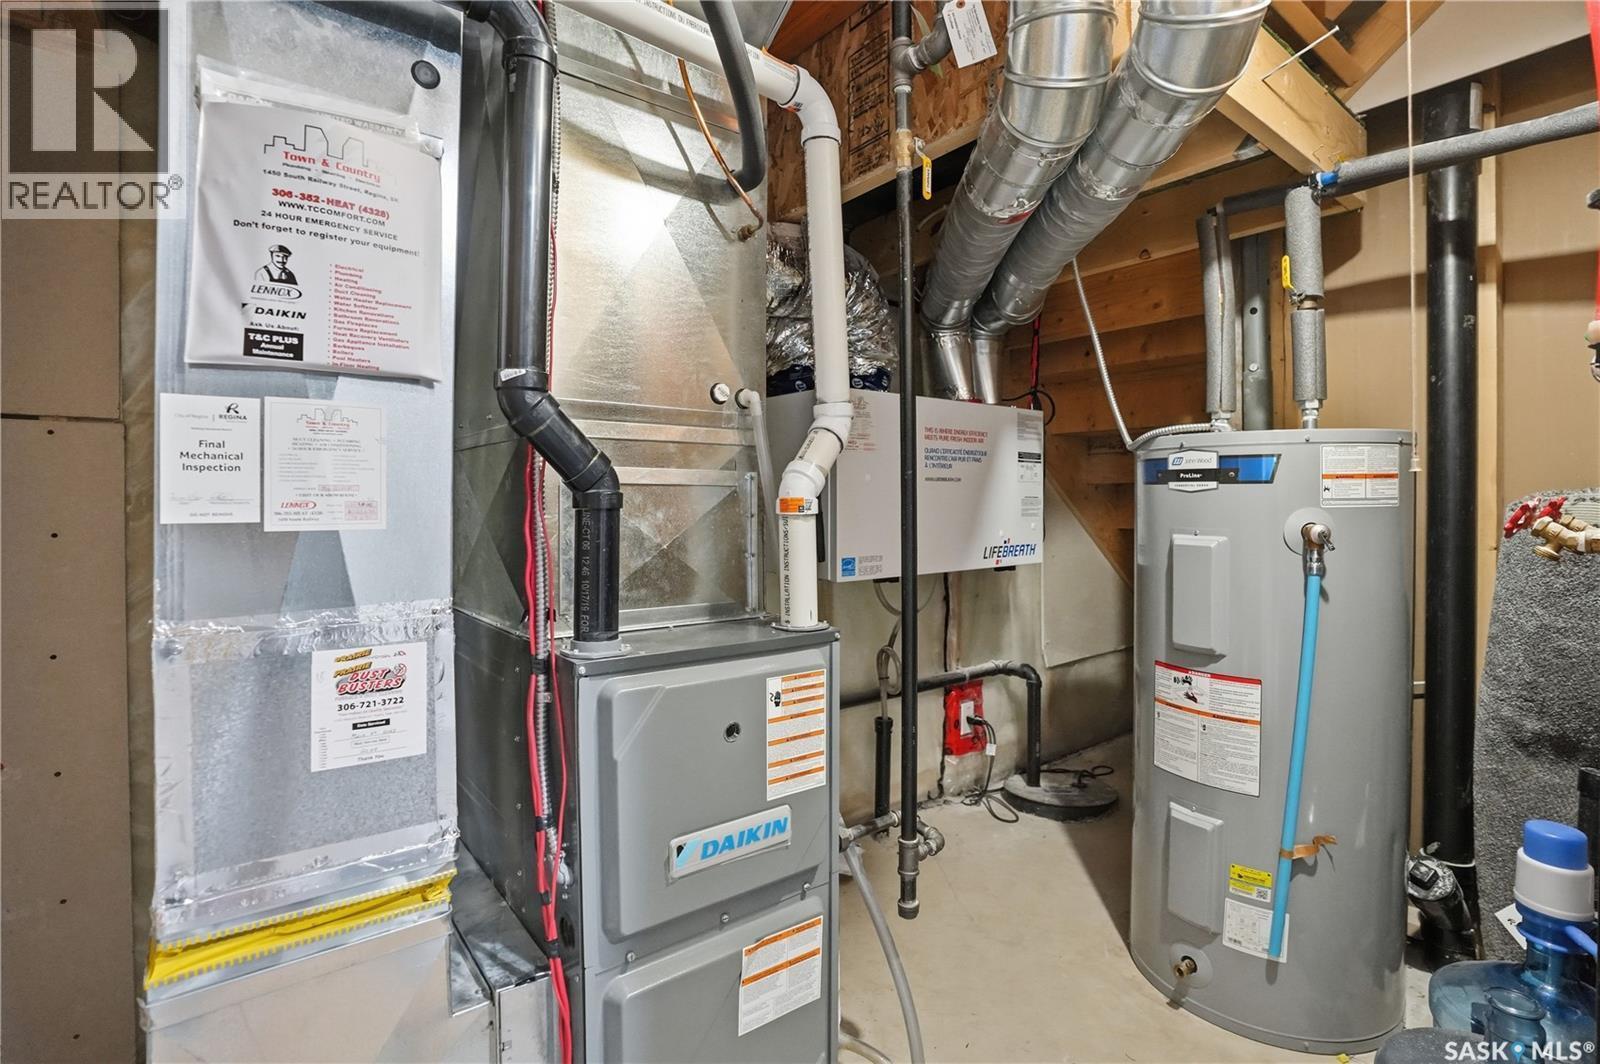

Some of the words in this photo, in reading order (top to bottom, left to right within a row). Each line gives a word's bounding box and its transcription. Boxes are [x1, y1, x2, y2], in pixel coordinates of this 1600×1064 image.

[282, 151, 316, 165] Town
[320, 158, 330, 168] &
[336, 161, 381, 183] Country
[262, 169, 282, 177] 1450
[284, 172, 306, 181] South
[308, 176, 337, 188] Railway
[339, 180, 362, 193] Street,
[278, 200, 386, 227] WWW.TCCOMFORT.COM
[358, 204, 390, 221] (4328)
[275, 213, 302, 222] HOUR
[305, 217, 360, 233] EMERGENCY
[363, 228, 398, 241] SERVICE
[233, 219, 259, 230] Don't
[262, 221, 293, 234] forget
[309, 230, 347, 244] register
[350, 238, 371, 248] your
[373, 243, 420, 258] equipment!
[334, 270, 362, 279] Plumbing
[334, 276, 358, 284] Heating
[250, 284, 295, 298] LENNOX
[344, 284, 382, 294] Conditioning
[350, 290, 376, 299] Cleaning
[254, 306, 307, 320] DAIKIN
[334, 313, 363, 321] Bathroom
[364, 316, 400, 325] Renovations
[359, 310, 394, 318] Renovations
[346, 320, 378, 329] Fireplaces
[248, 332, 270, 342] T&C
[272, 335, 298, 345] PLUS
[349, 333, 376, 341] Recovery
[360, 328, 398, 336] Replacement
[198, 439, 226, 448] Final
[179, 451, 244, 460] Mechanical
[182, 463, 241, 473] Inspection
[983, 543, 1036, 560] LIFEBREATH
[333, 662, 373, 678] PRAIRIE
[348, 668, 391, 682] DUST
[336, 677, 405, 695] BUSTERS
[337, 696, 404, 712] 306-721-3722
[700, 816, 788, 861] DAIKIN
